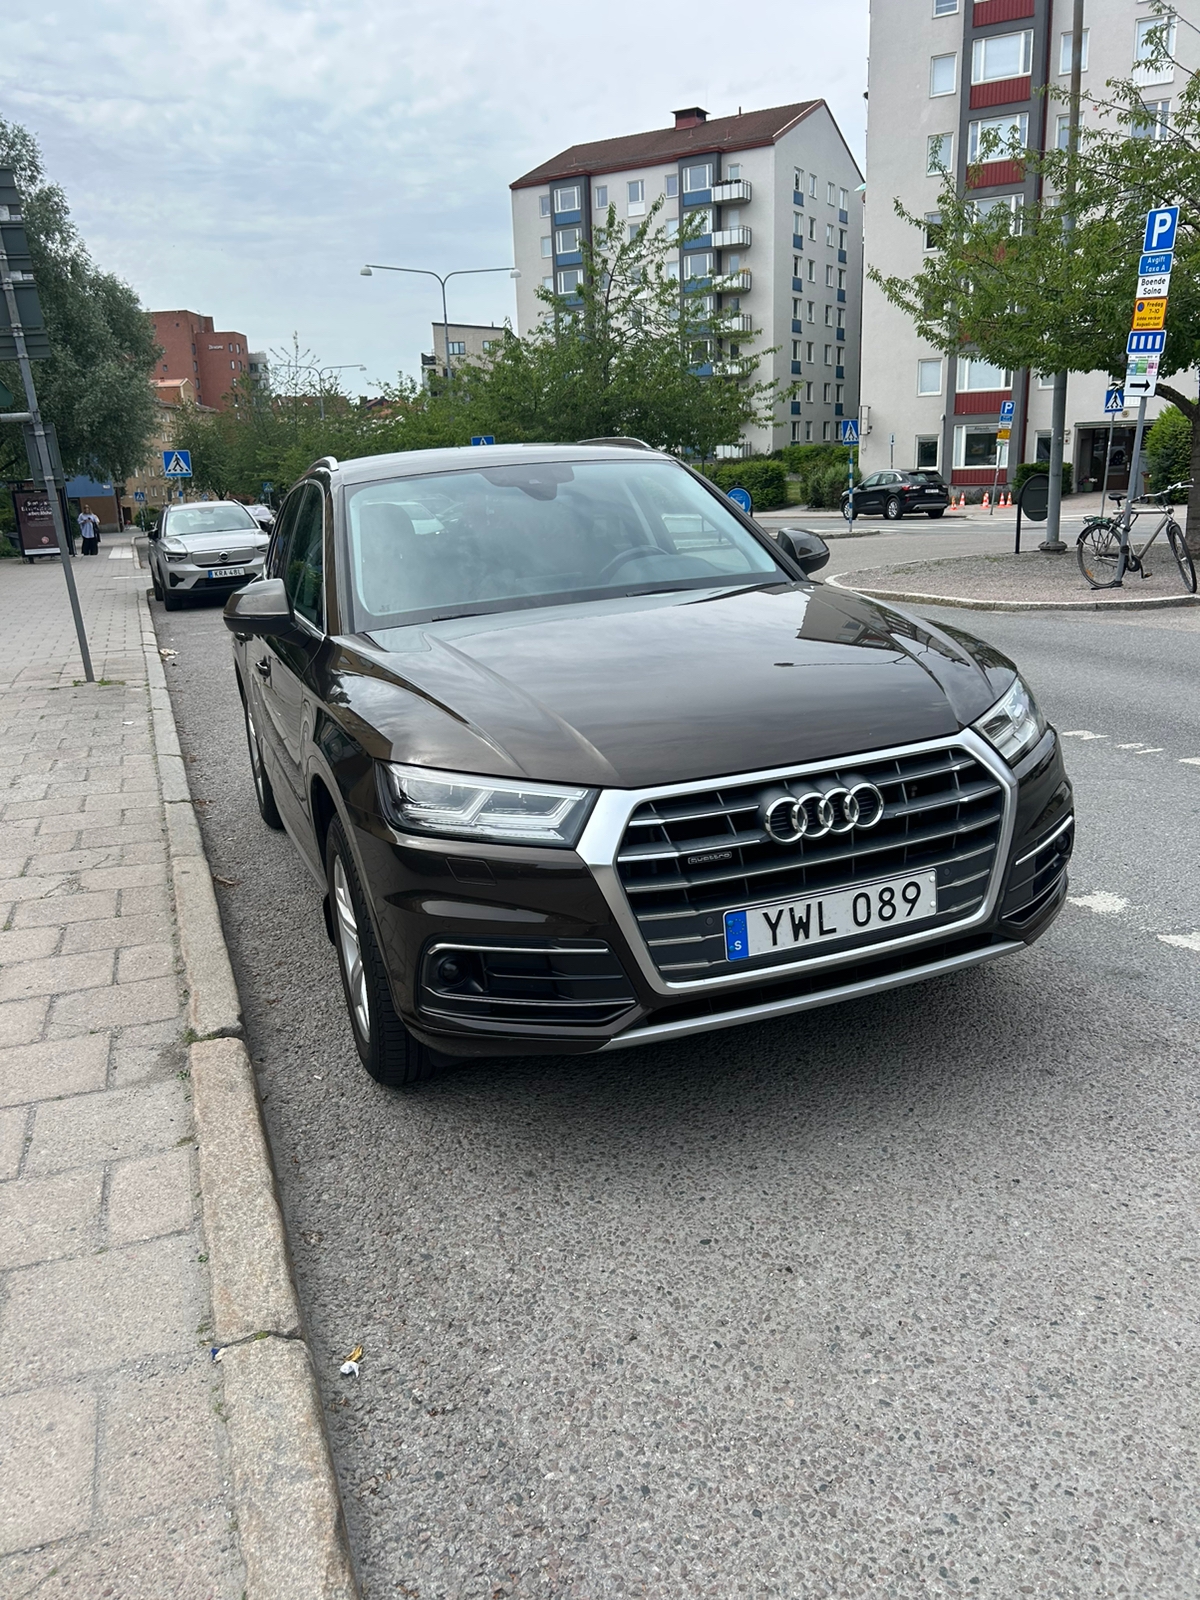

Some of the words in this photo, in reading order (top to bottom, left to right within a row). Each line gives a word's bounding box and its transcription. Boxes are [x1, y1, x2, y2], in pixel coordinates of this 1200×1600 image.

[1152, 212, 1172, 248] P
[1147, 256, 1166, 265] Avgift
[1145, 265, 1160, 273] Taxa
[1141, 277, 1166, 287] Boende
[1142, 287, 1162, 296] Solna
[1004, 402, 1012, 414] P
[691, 853, 730, 863] quattro
[762, 901, 837, 946] YWL
[852, 882, 922, 927] 089
[734, 940, 743, 951] S
